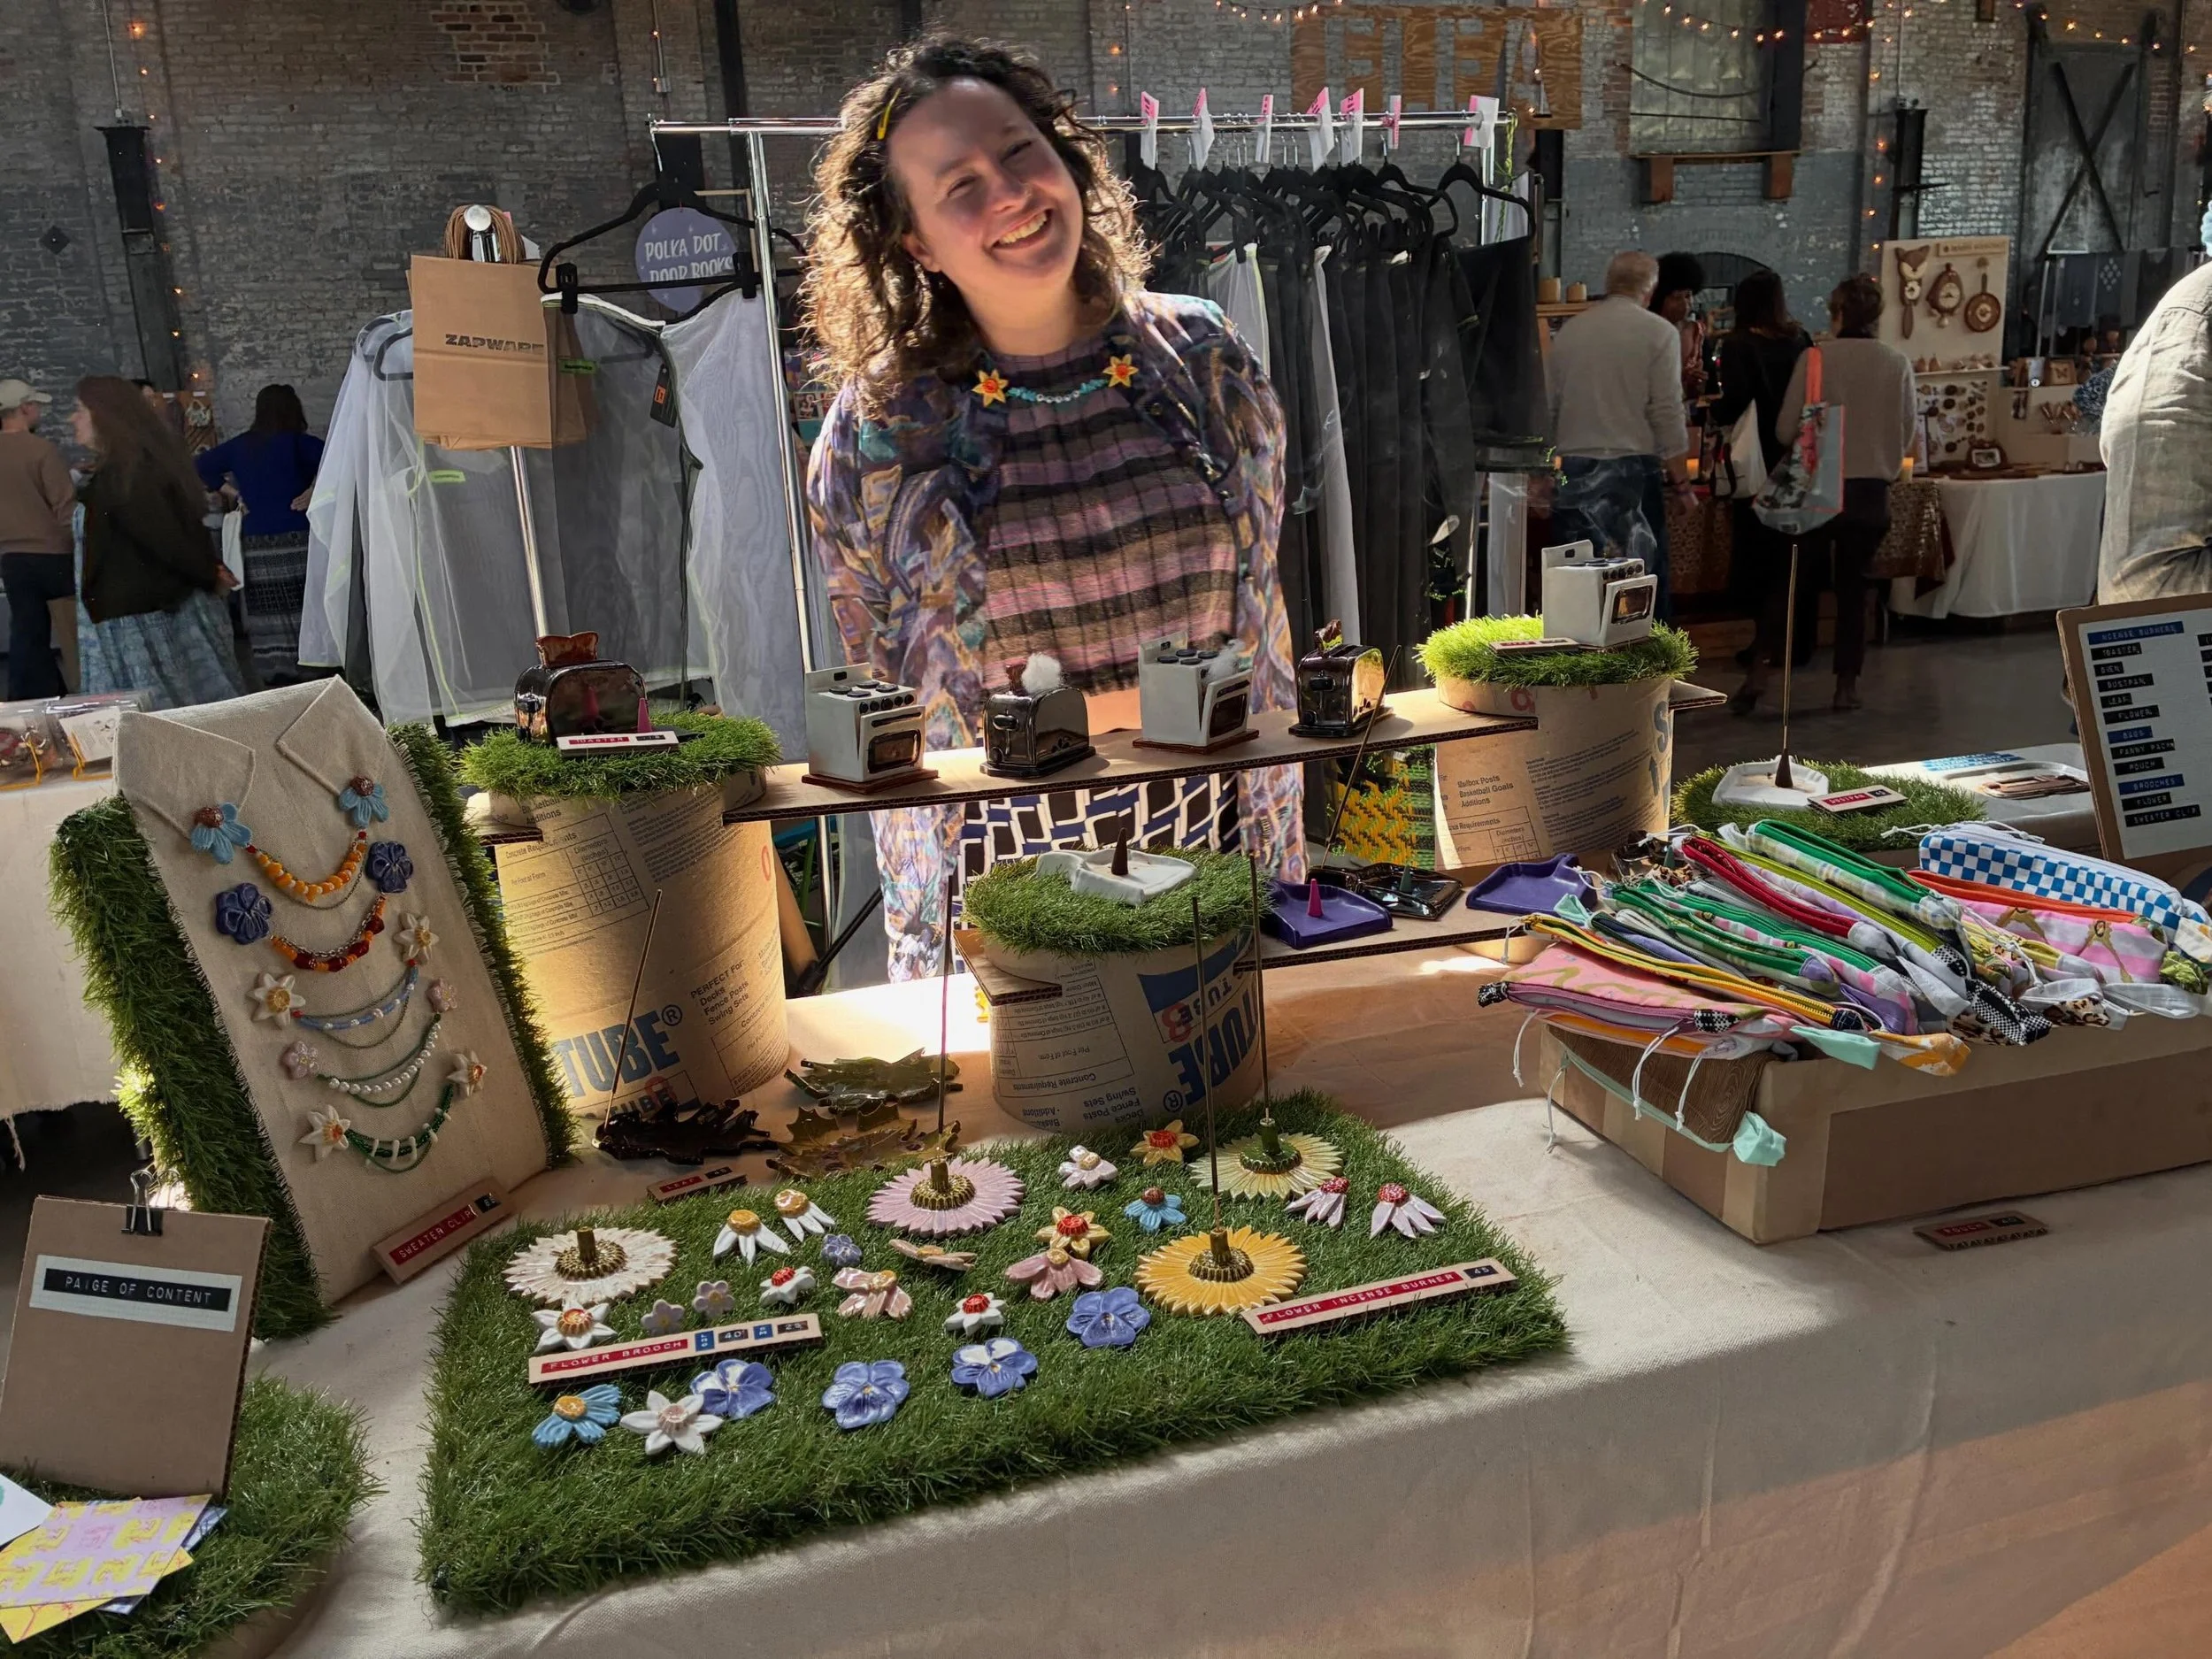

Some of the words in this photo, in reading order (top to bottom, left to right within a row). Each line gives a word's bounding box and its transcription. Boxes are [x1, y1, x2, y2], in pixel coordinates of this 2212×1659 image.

[645, 239, 688, 262] POLKA
[693, 233, 721, 254] DOT
[1459, 787, 1491, 798] Basketball
[1492, 782, 1515, 793] Goals
[1479, 775, 1501, 784] Posts
[1461, 797, 1491, 808] Additions
[690, 969, 733, 999] PERFECT
[700, 986, 726, 1007] Decks
[704, 996, 729, 1017] Fence
[729, 981, 749, 999] Posts
[708, 1006, 734, 1025] Swing
[734, 994, 749, 1008] Sets
[1060, 1072, 1096, 1087] Concrete
[1083, 1098, 1105, 1108] Sets
[1106, 1087, 1137, 1101] Swing
[1083, 1109, 1110, 1121] Posts
[1111, 1097, 1141, 1113] Fence
[398, 1227, 445, 1258] SWEATER
[448, 1210, 473, 1228] CLIP
[65, 1275, 109, 1293] PAIGE
[119, 1282, 136, 1295] OF
[147, 1285, 211, 1303] CONTENT
[1267, 1303, 1321, 1320] FLOWER
[1332, 1287, 1393, 1306] INCENSE
[1401, 1274, 1455, 1290] BURNER
[550, 1354, 610, 1370] FLOWER
[622, 1341, 681, 1357] BROOCH
